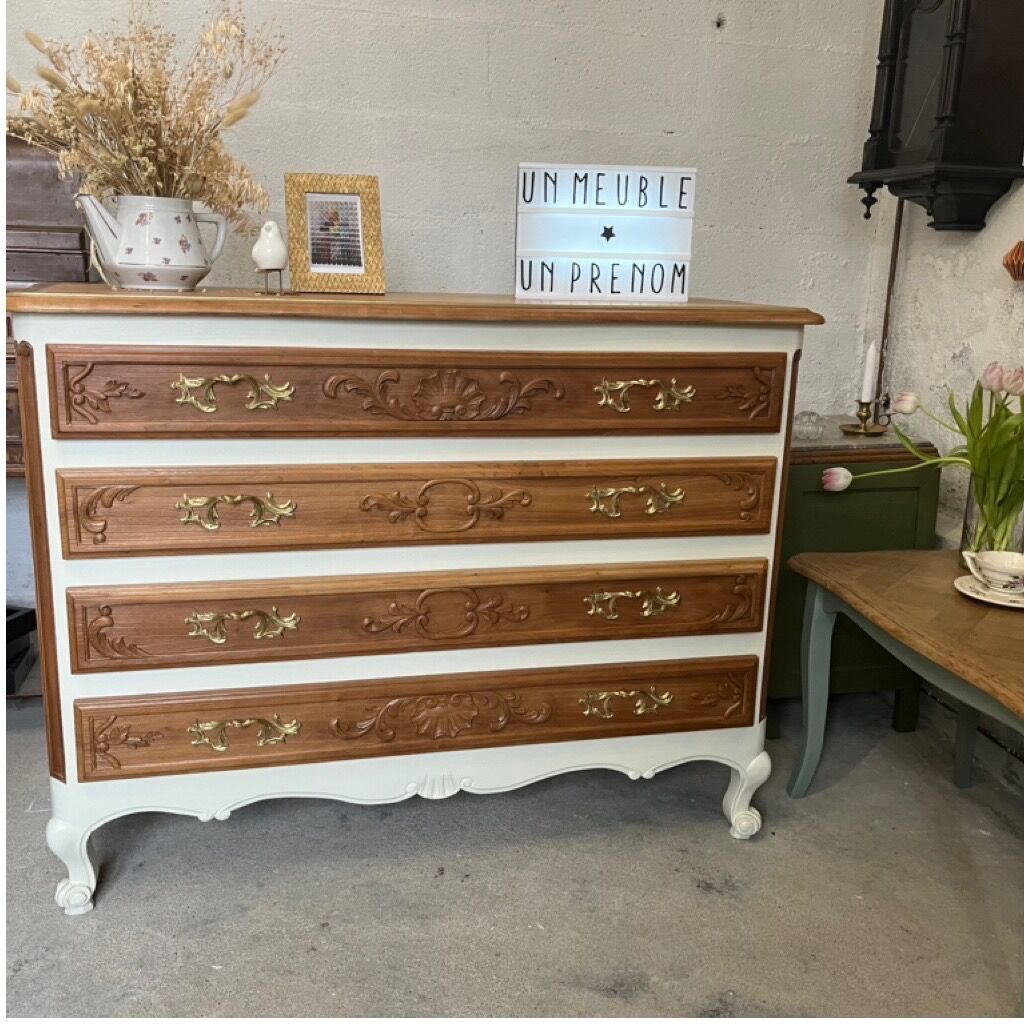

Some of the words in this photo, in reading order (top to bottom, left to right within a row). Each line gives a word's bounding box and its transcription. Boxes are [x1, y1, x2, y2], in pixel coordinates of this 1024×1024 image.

[522, 171, 558, 204] UN
[572, 172, 692, 209] MEUBLE
[520, 259, 554, 293] UN
[570, 262, 686, 294] PRENOM
